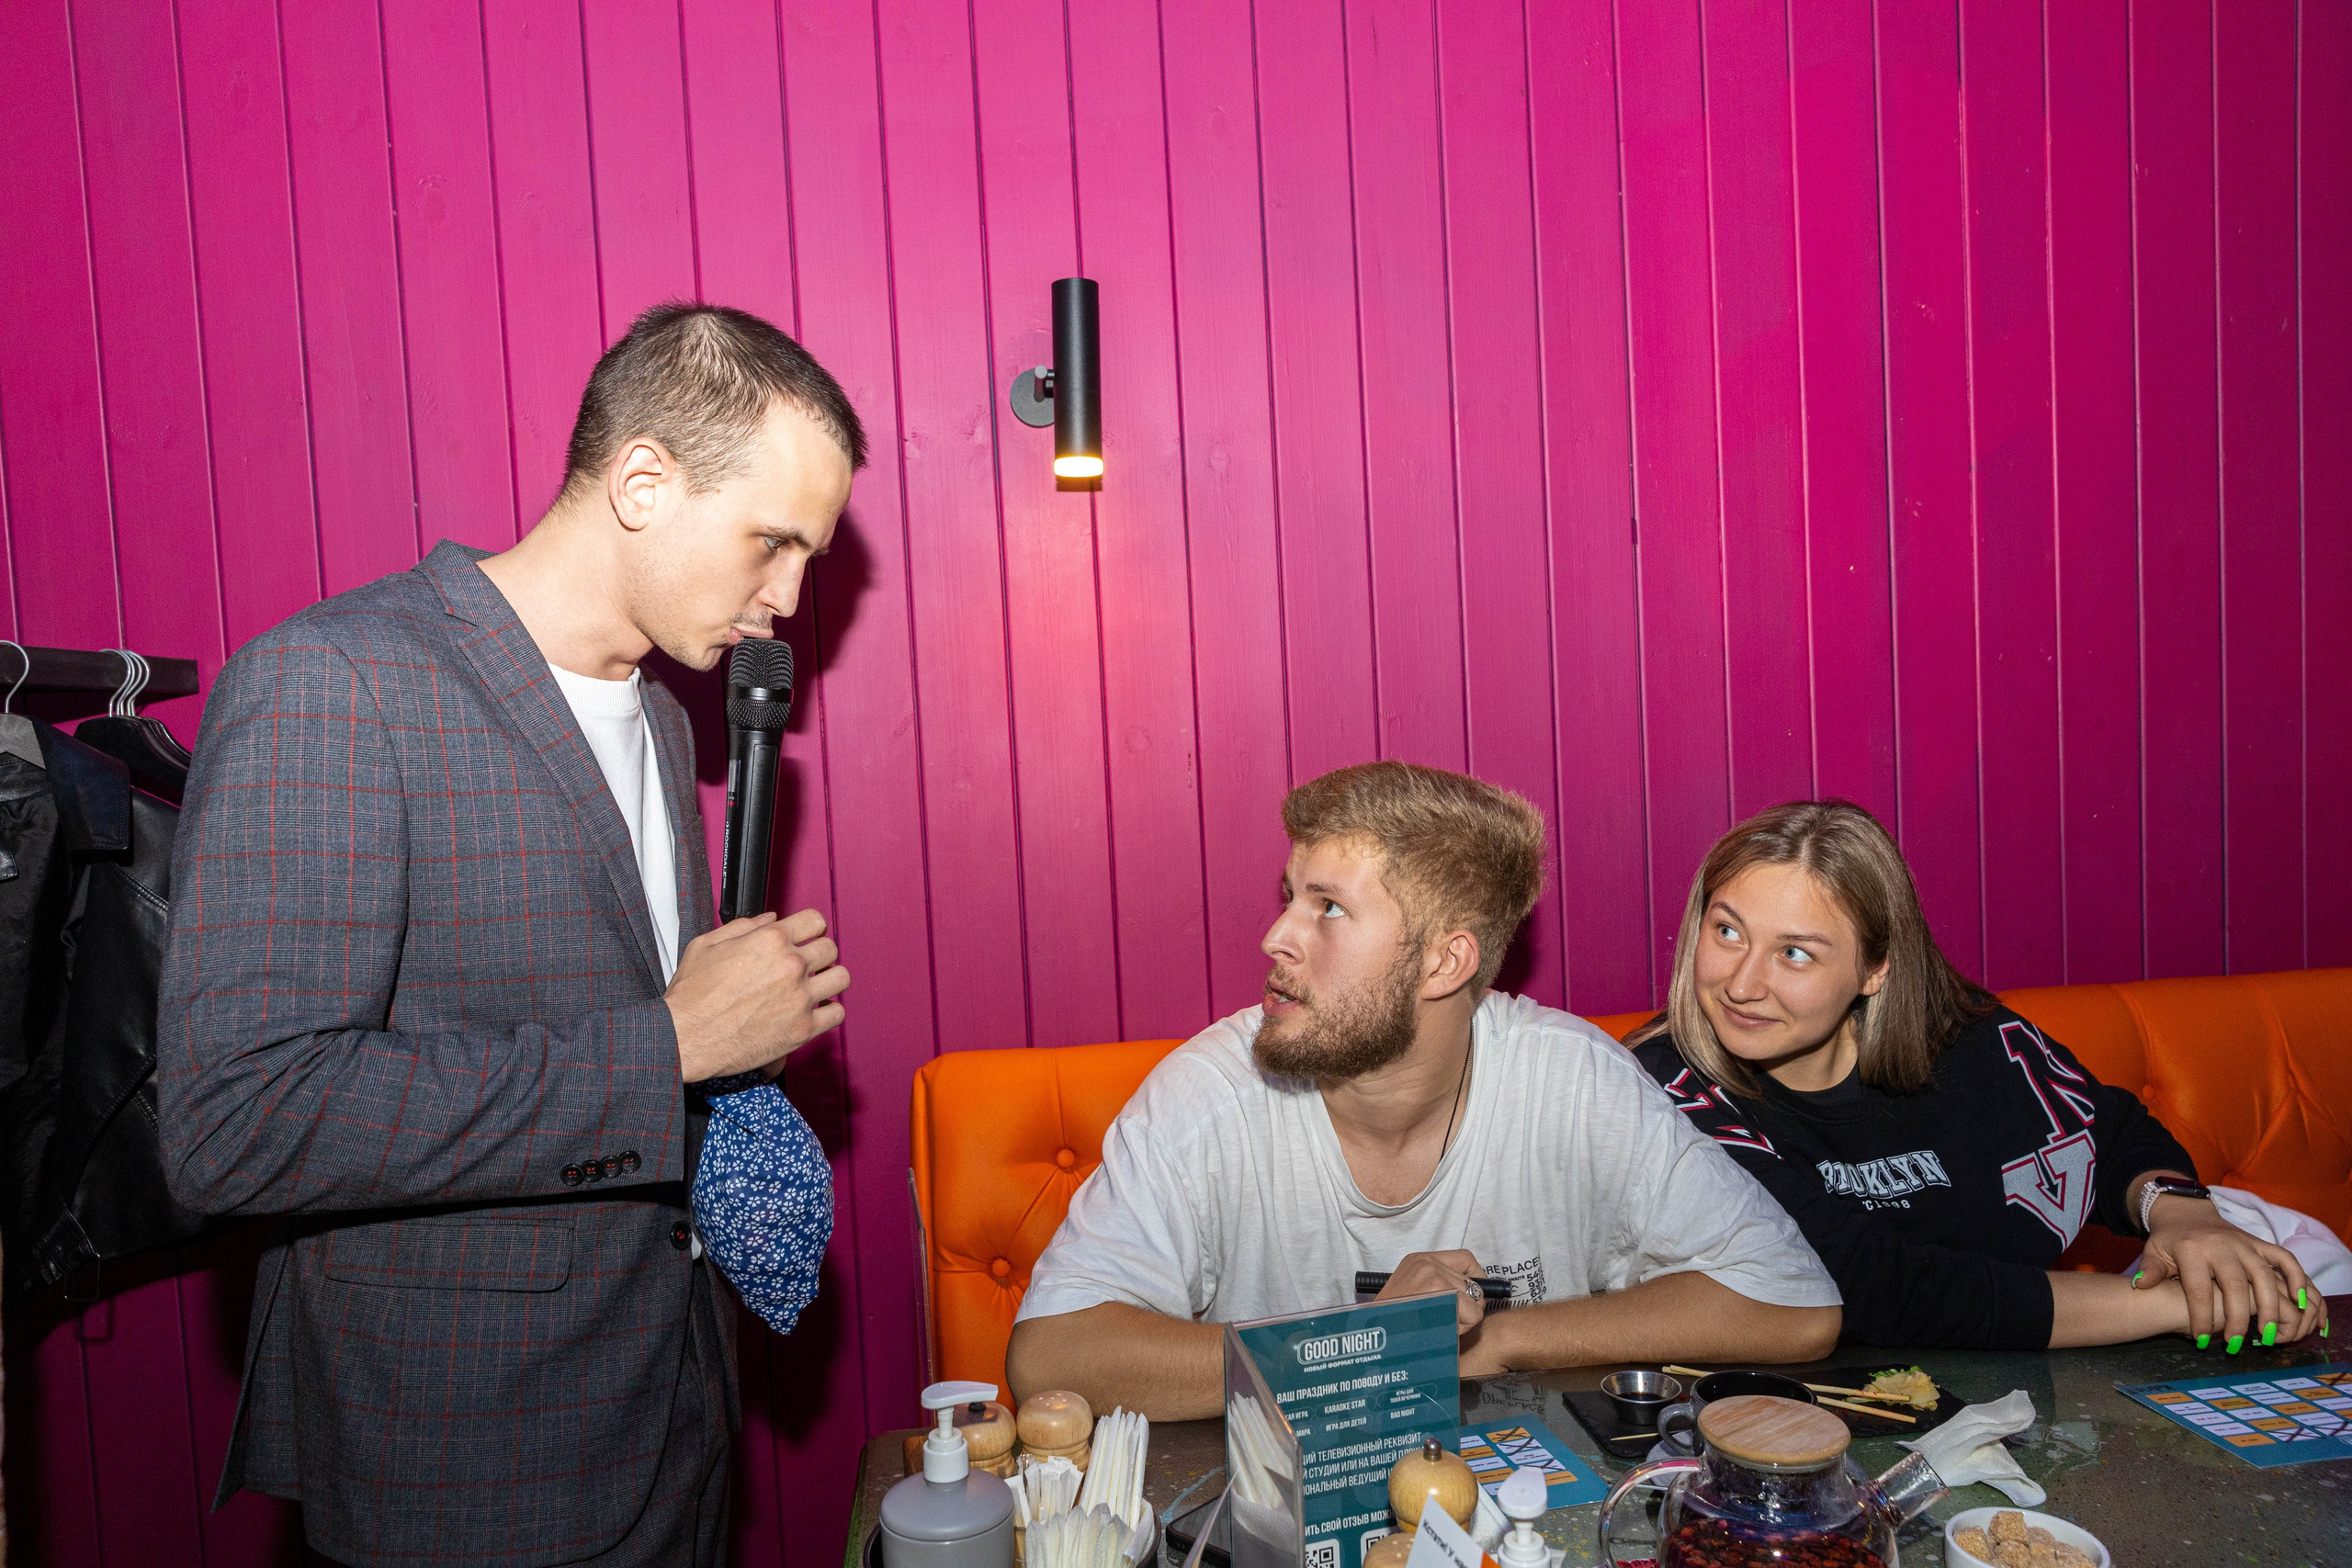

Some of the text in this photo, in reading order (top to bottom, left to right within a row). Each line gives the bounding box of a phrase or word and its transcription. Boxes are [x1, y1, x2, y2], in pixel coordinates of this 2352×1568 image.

[1305, 1331, 1380, 1360] GOOD NIGHT
[1304, 1354, 1382, 1372] НОВЫЙ ФОРМАТ ОТДЫХА
[1276, 1371, 1408, 1404] ВАШ ПРАЗДНИК ПО ПОВОДУ И БЕЗ:
[1324, 1399, 1366, 1414] KARAOKE STAR
[1390, 1411, 1401, 1419] BAD
[1326, 1416, 1367, 1432] ИГРА ДЛЯ ДЕТЕЙ
[1317, 1438, 1383, 1461] ТЕЛЕВИЗИОННЫЙ
[1384, 1432, 1421, 1449] РЕКВИЗИТ
[1308, 1465, 1340, 1479] СТУДИИ
[1341, 1461, 1357, 1472] ИЛИ
[1358, 1459, 1369, 1470] НА
[1370, 1451, 1396, 1467] ВАШЕЙ
[1349, 1467, 1386, 1487] ВЕДУЩИЙ
[1321, 1517, 1341, 1533] СВОЙ
[1342, 1513, 1369, 1529] ОТЗЫВ
[1370, 1509, 1396, 1523] МОЖН
